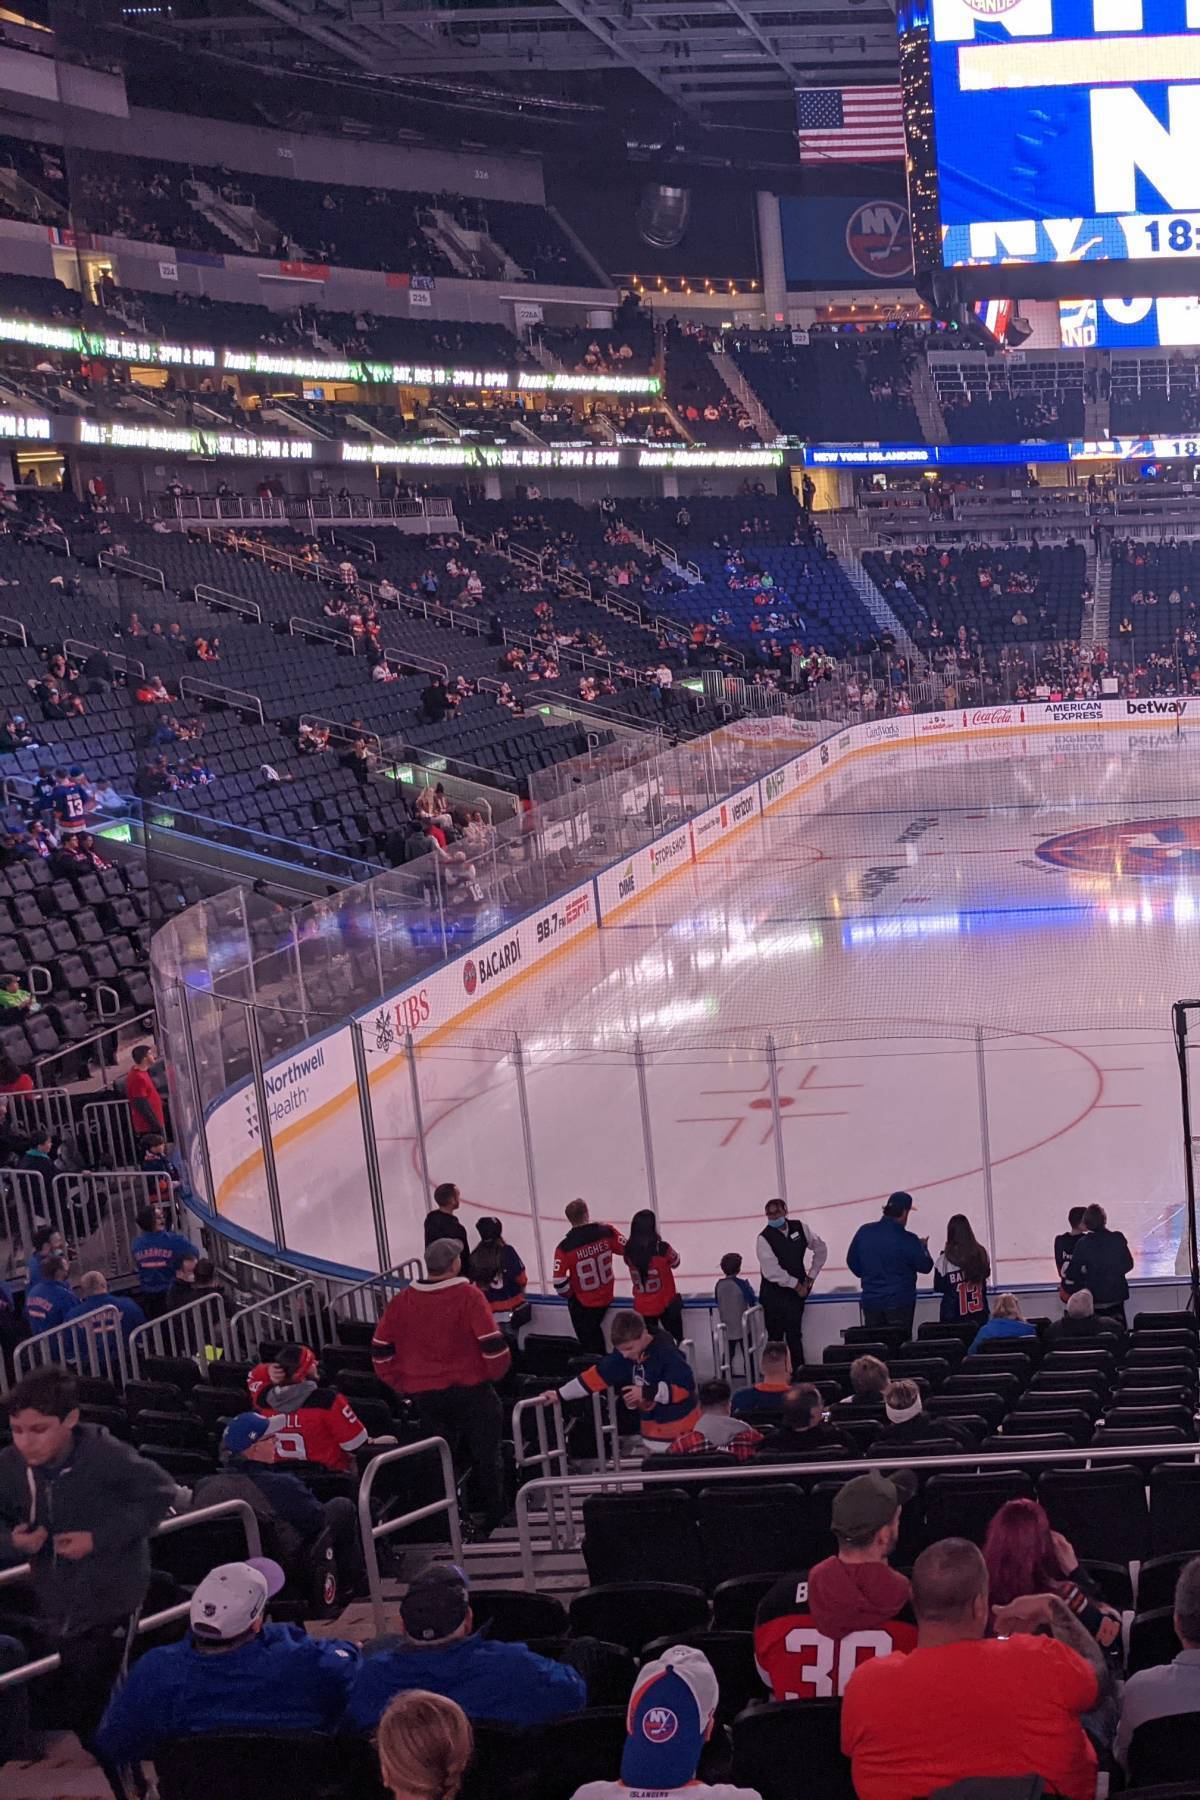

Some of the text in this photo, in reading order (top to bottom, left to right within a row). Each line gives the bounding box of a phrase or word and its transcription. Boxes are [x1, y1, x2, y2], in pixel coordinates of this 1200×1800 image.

[813, 452, 838, 462] NEW
[1044, 702, 1102, 713] AMERICAN
[1053, 711, 1103, 721] EXPRESS
[1126, 700, 1188, 716] betway
[732, 796, 754, 822] verizon
[618, 874, 635, 899] DIME
[537, 912, 558, 943] 98.7
[394, 989, 430, 1036] UBS
[264, 1047, 325, 1099] Northwell
[268, 1086, 308, 1126] Health
[576, 1240, 609, 1259] HUGHES
[956, 1281, 984, 1316] 13
